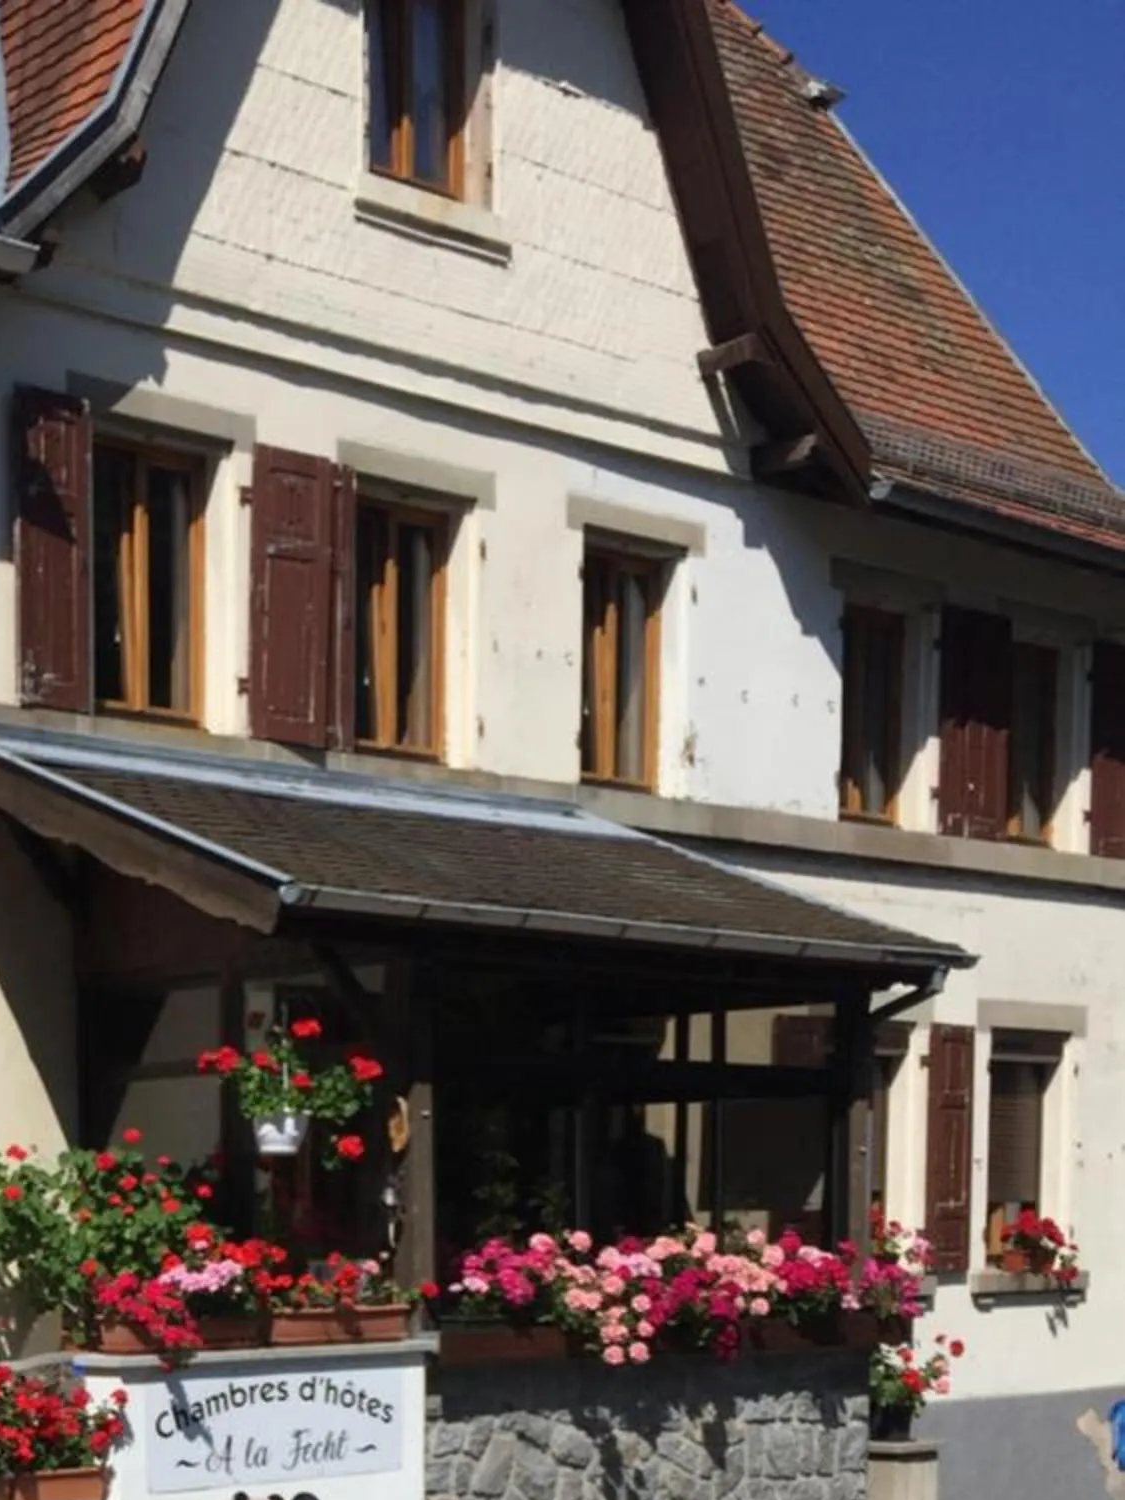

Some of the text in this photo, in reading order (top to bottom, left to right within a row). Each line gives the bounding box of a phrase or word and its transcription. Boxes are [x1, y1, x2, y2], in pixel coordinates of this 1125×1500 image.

[155, 1376, 395, 1439] Chambres d'hôtes
[205, 1428, 352, 1475] A la Fecht
